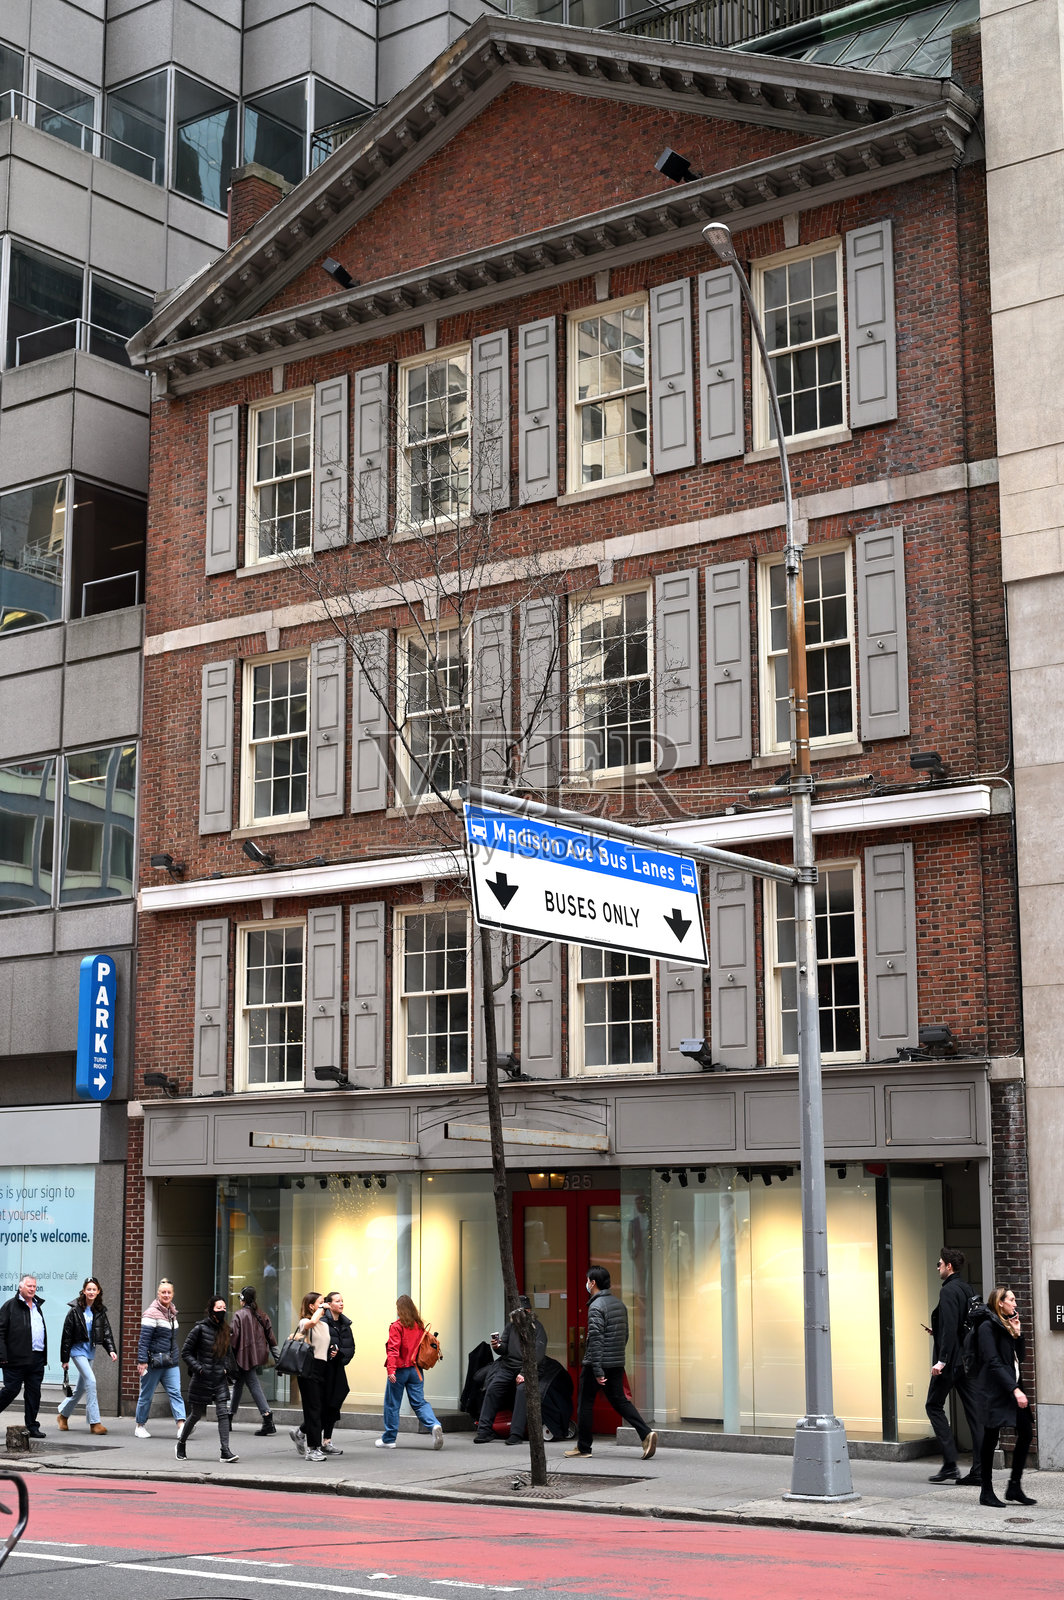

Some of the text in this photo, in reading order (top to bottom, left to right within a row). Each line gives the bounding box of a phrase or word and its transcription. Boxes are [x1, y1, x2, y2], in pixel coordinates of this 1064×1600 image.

[493, 820, 676, 881] Madison Ave Bus Lanes
[544, 889, 640, 928] BUSES ONLY
[94, 962, 111, 1054] PARK
[6, 1185, 14, 1199] is
[16, 1187, 38, 1202] your
[40, 1184, 62, 1202] sign
[64, 1186, 75, 1199] to
[8, 1205, 49, 1224] yourself.
[40, 1228, 90, 1243] welcome.
[52, 1271, 65, 1280] One
[3, 1283, 14, 1292] and
